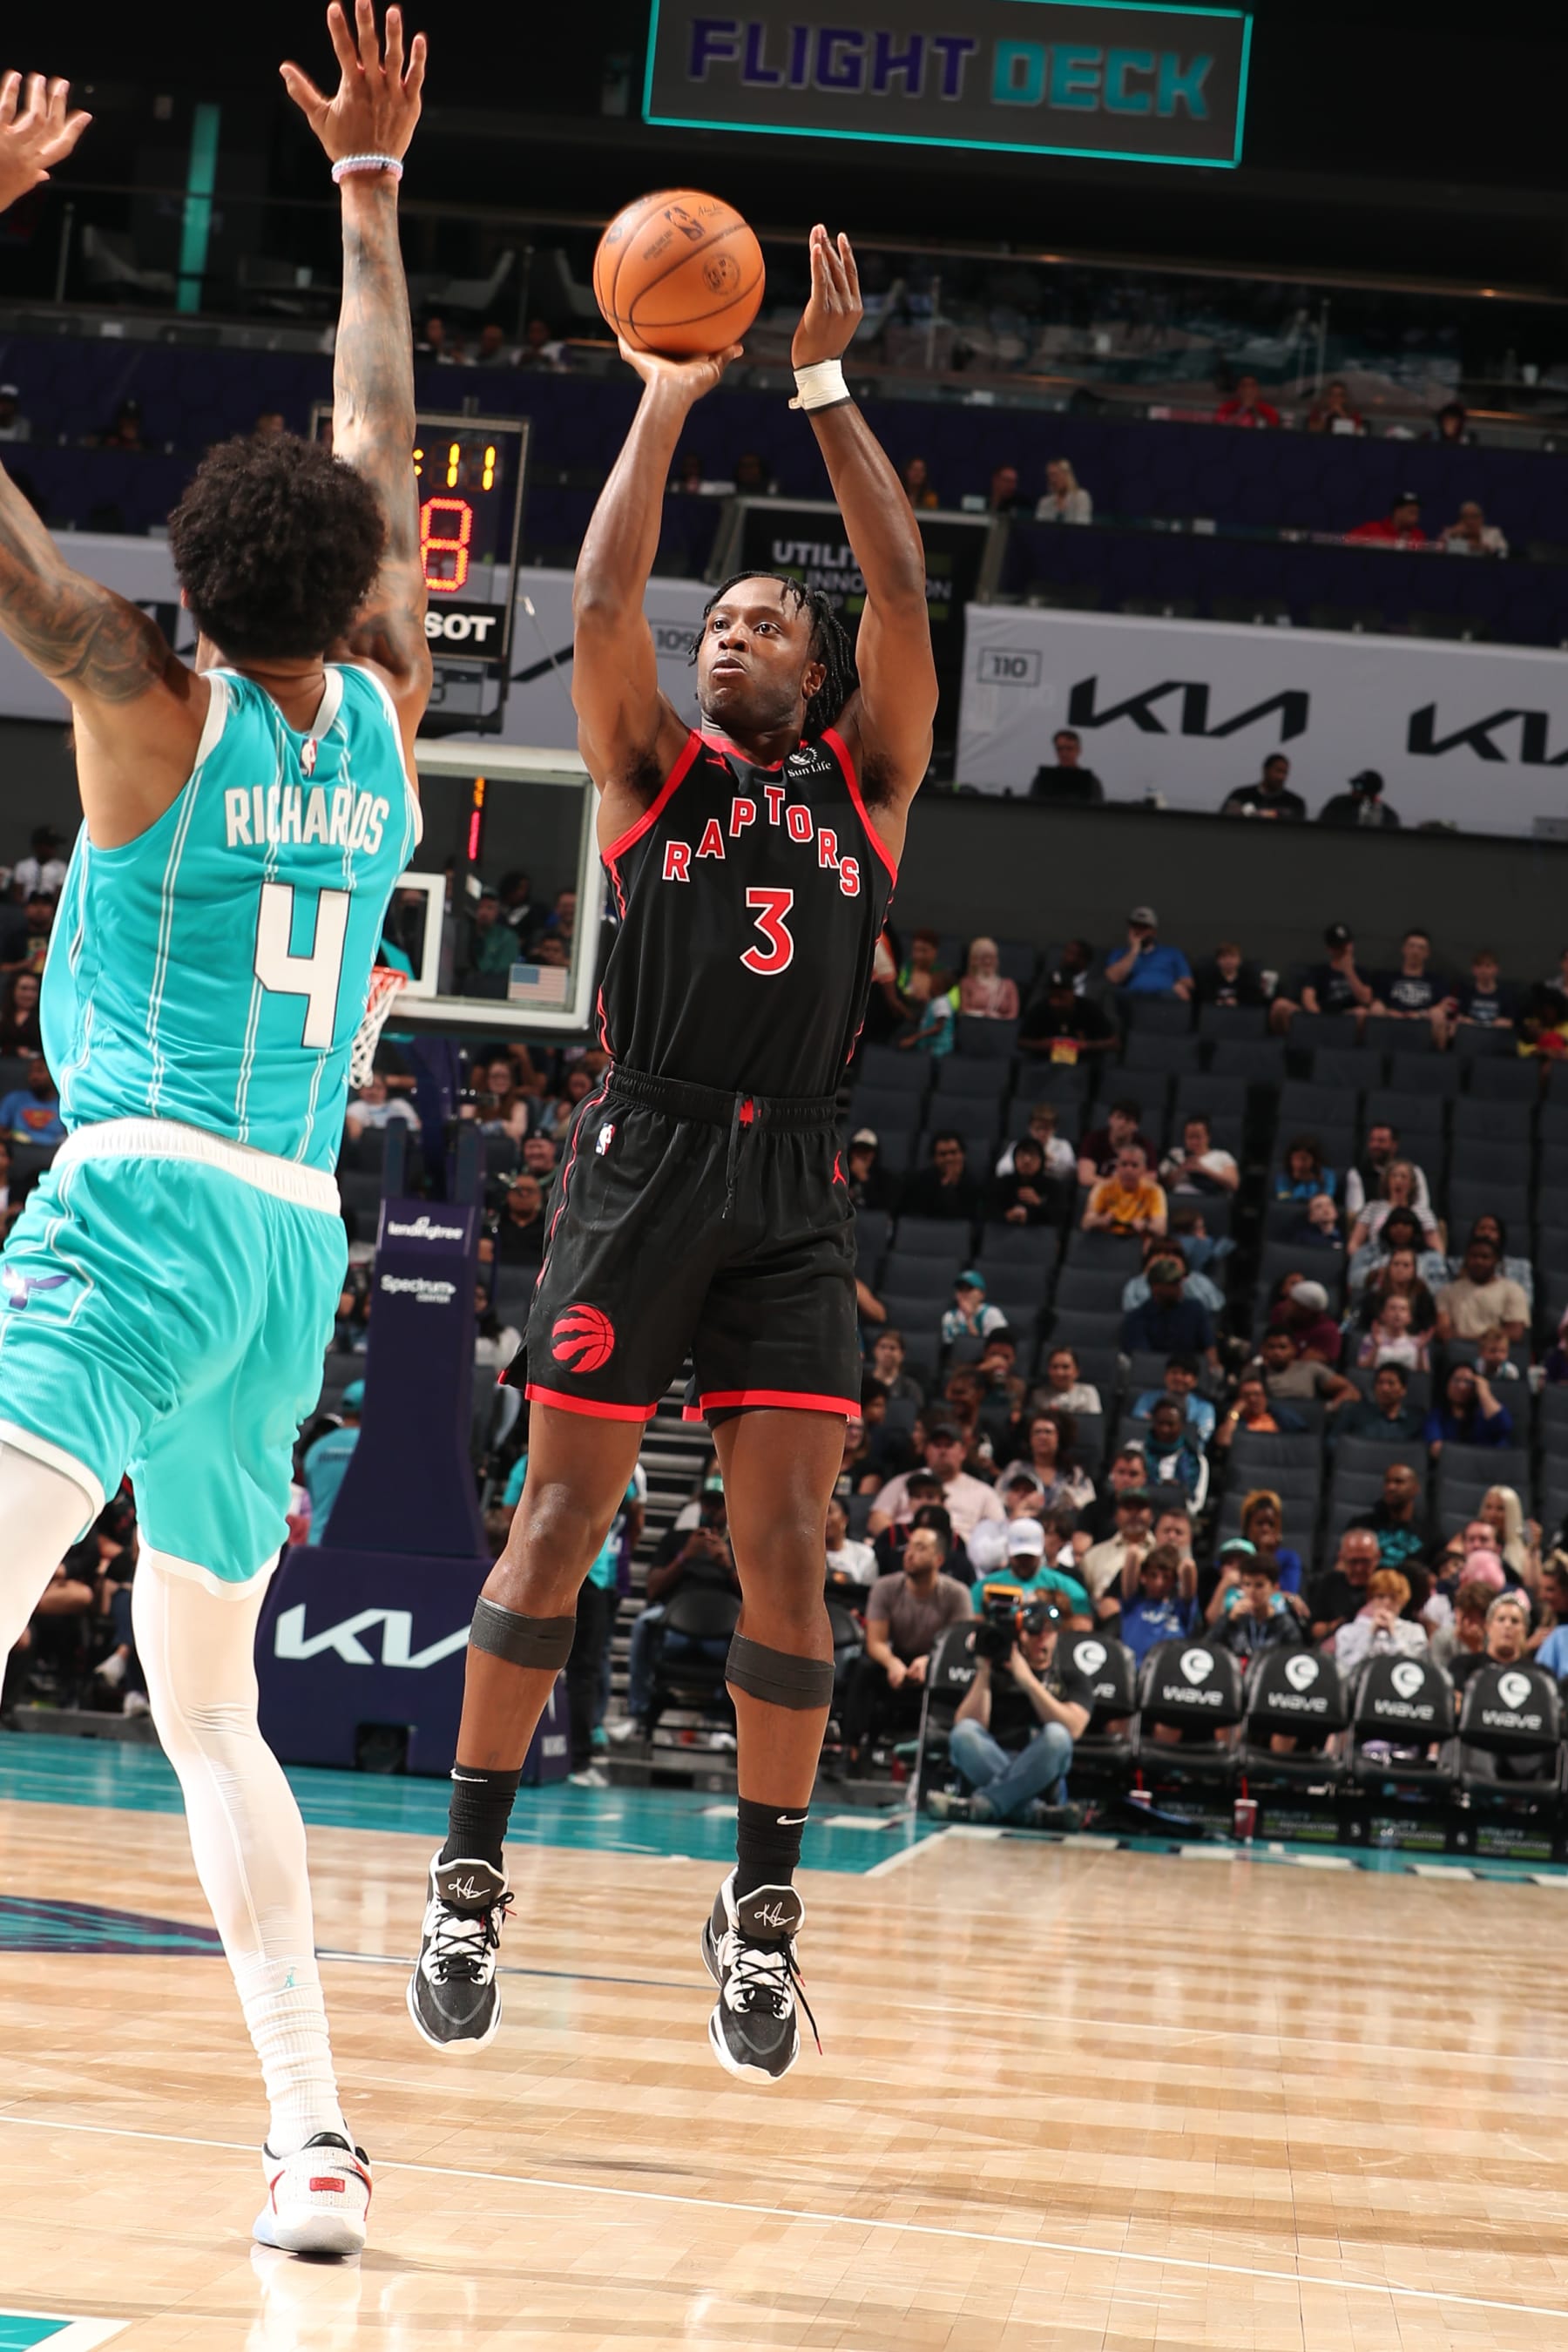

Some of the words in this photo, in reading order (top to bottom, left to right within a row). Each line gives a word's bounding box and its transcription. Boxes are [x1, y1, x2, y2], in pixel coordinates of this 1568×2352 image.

[687, 17, 978, 101] FLIGHT
[991, 38, 1213, 118] DECK
[772, 539, 859, 568] UTILIT
[806, 569, 953, 598] INNOON
[424, 611, 497, 642] SOT
[994, 655, 1028, 679] 110
[1407, 701, 1568, 767] KI
[787, 767, 810, 778] Sun
[810, 760, 832, 774] Life
[224, 785, 390, 855] RICHARDS
[662, 785, 860, 897] RAPTORS
[740, 887, 794, 976] 3
[253, 881, 351, 1049] 4
